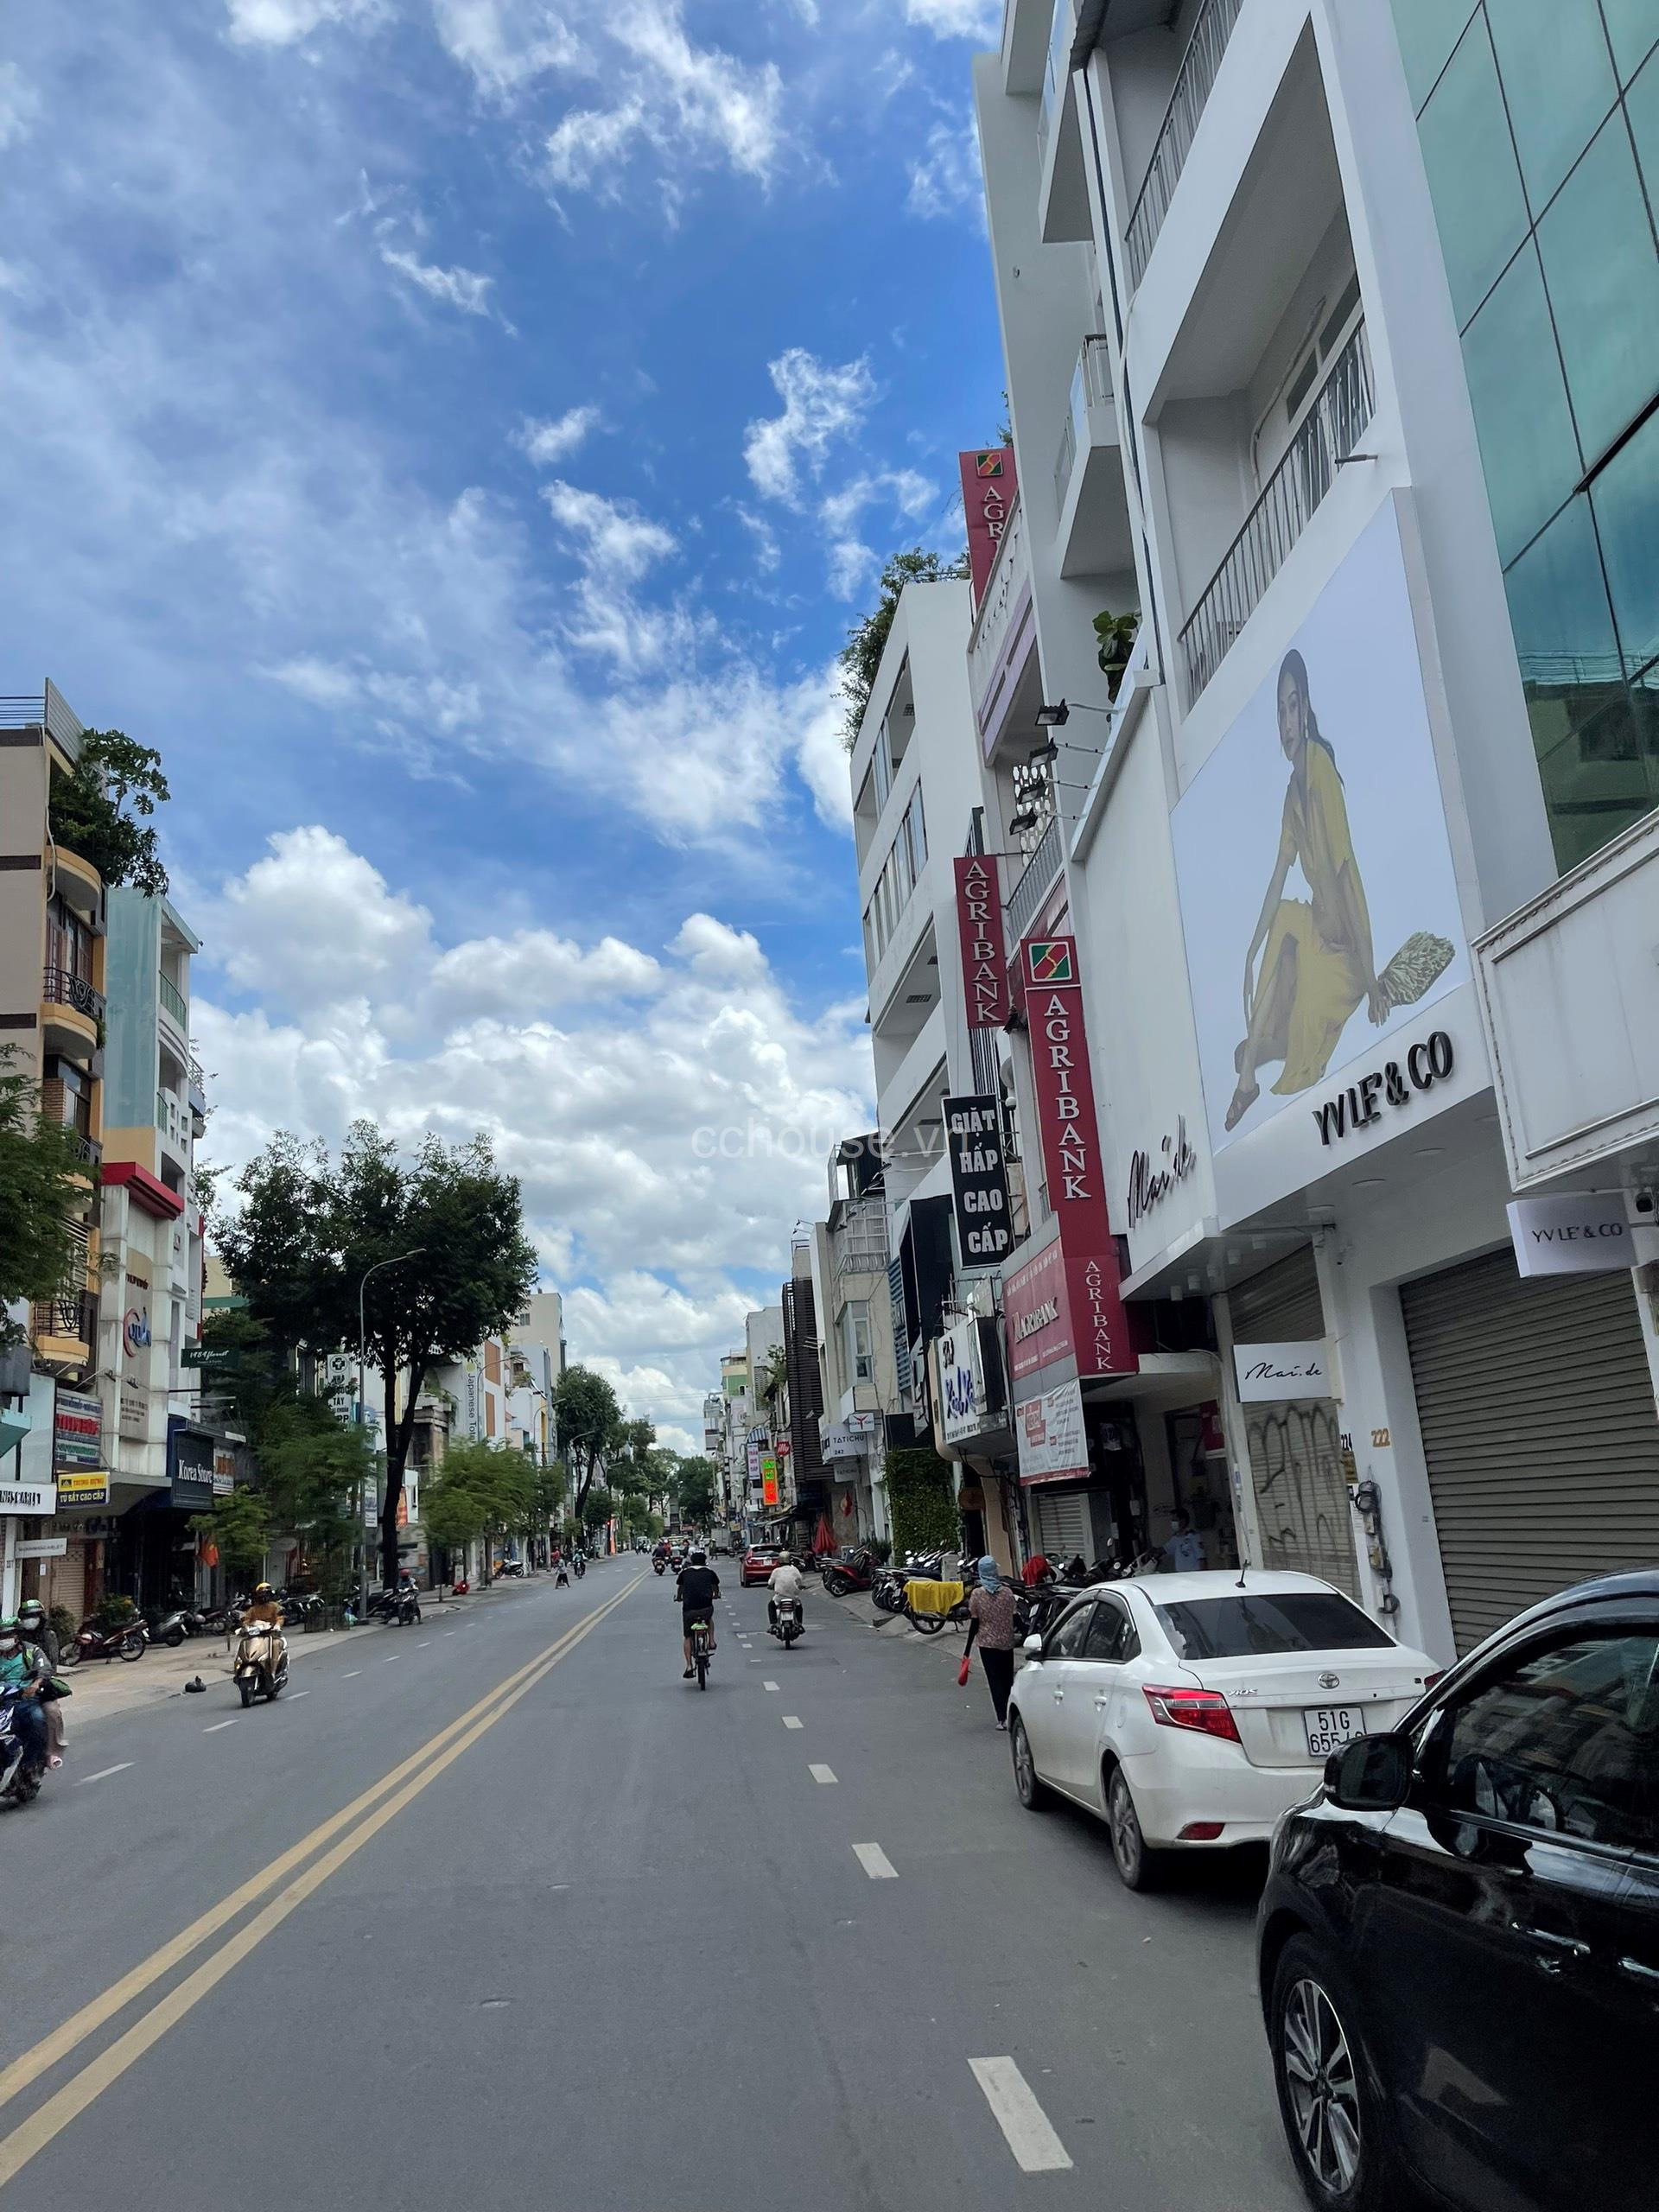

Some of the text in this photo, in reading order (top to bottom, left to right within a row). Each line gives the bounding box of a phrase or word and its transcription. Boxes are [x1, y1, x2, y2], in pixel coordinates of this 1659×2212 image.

[963, 861, 1002, 1022] AGRIBANK
[1044, 994, 1092, 1199] AGRIBANK
[950, 1107, 995, 1137] GIẶT
[959, 1141, 998, 1173] HẤP
[963, 1188, 1003, 1213] CAO
[968, 1221, 1008, 1253] CẤP
[1084, 1260, 1114, 1370] AGRIBANK
[833, 1435, 865, 1444] TATICHU
[178, 1459, 197, 1482] Korea
[197, 1463, 213, 1484] Store
[1318, 1711, 1350, 1731] 51G
[1310, 1732, 1363, 1752] 655
